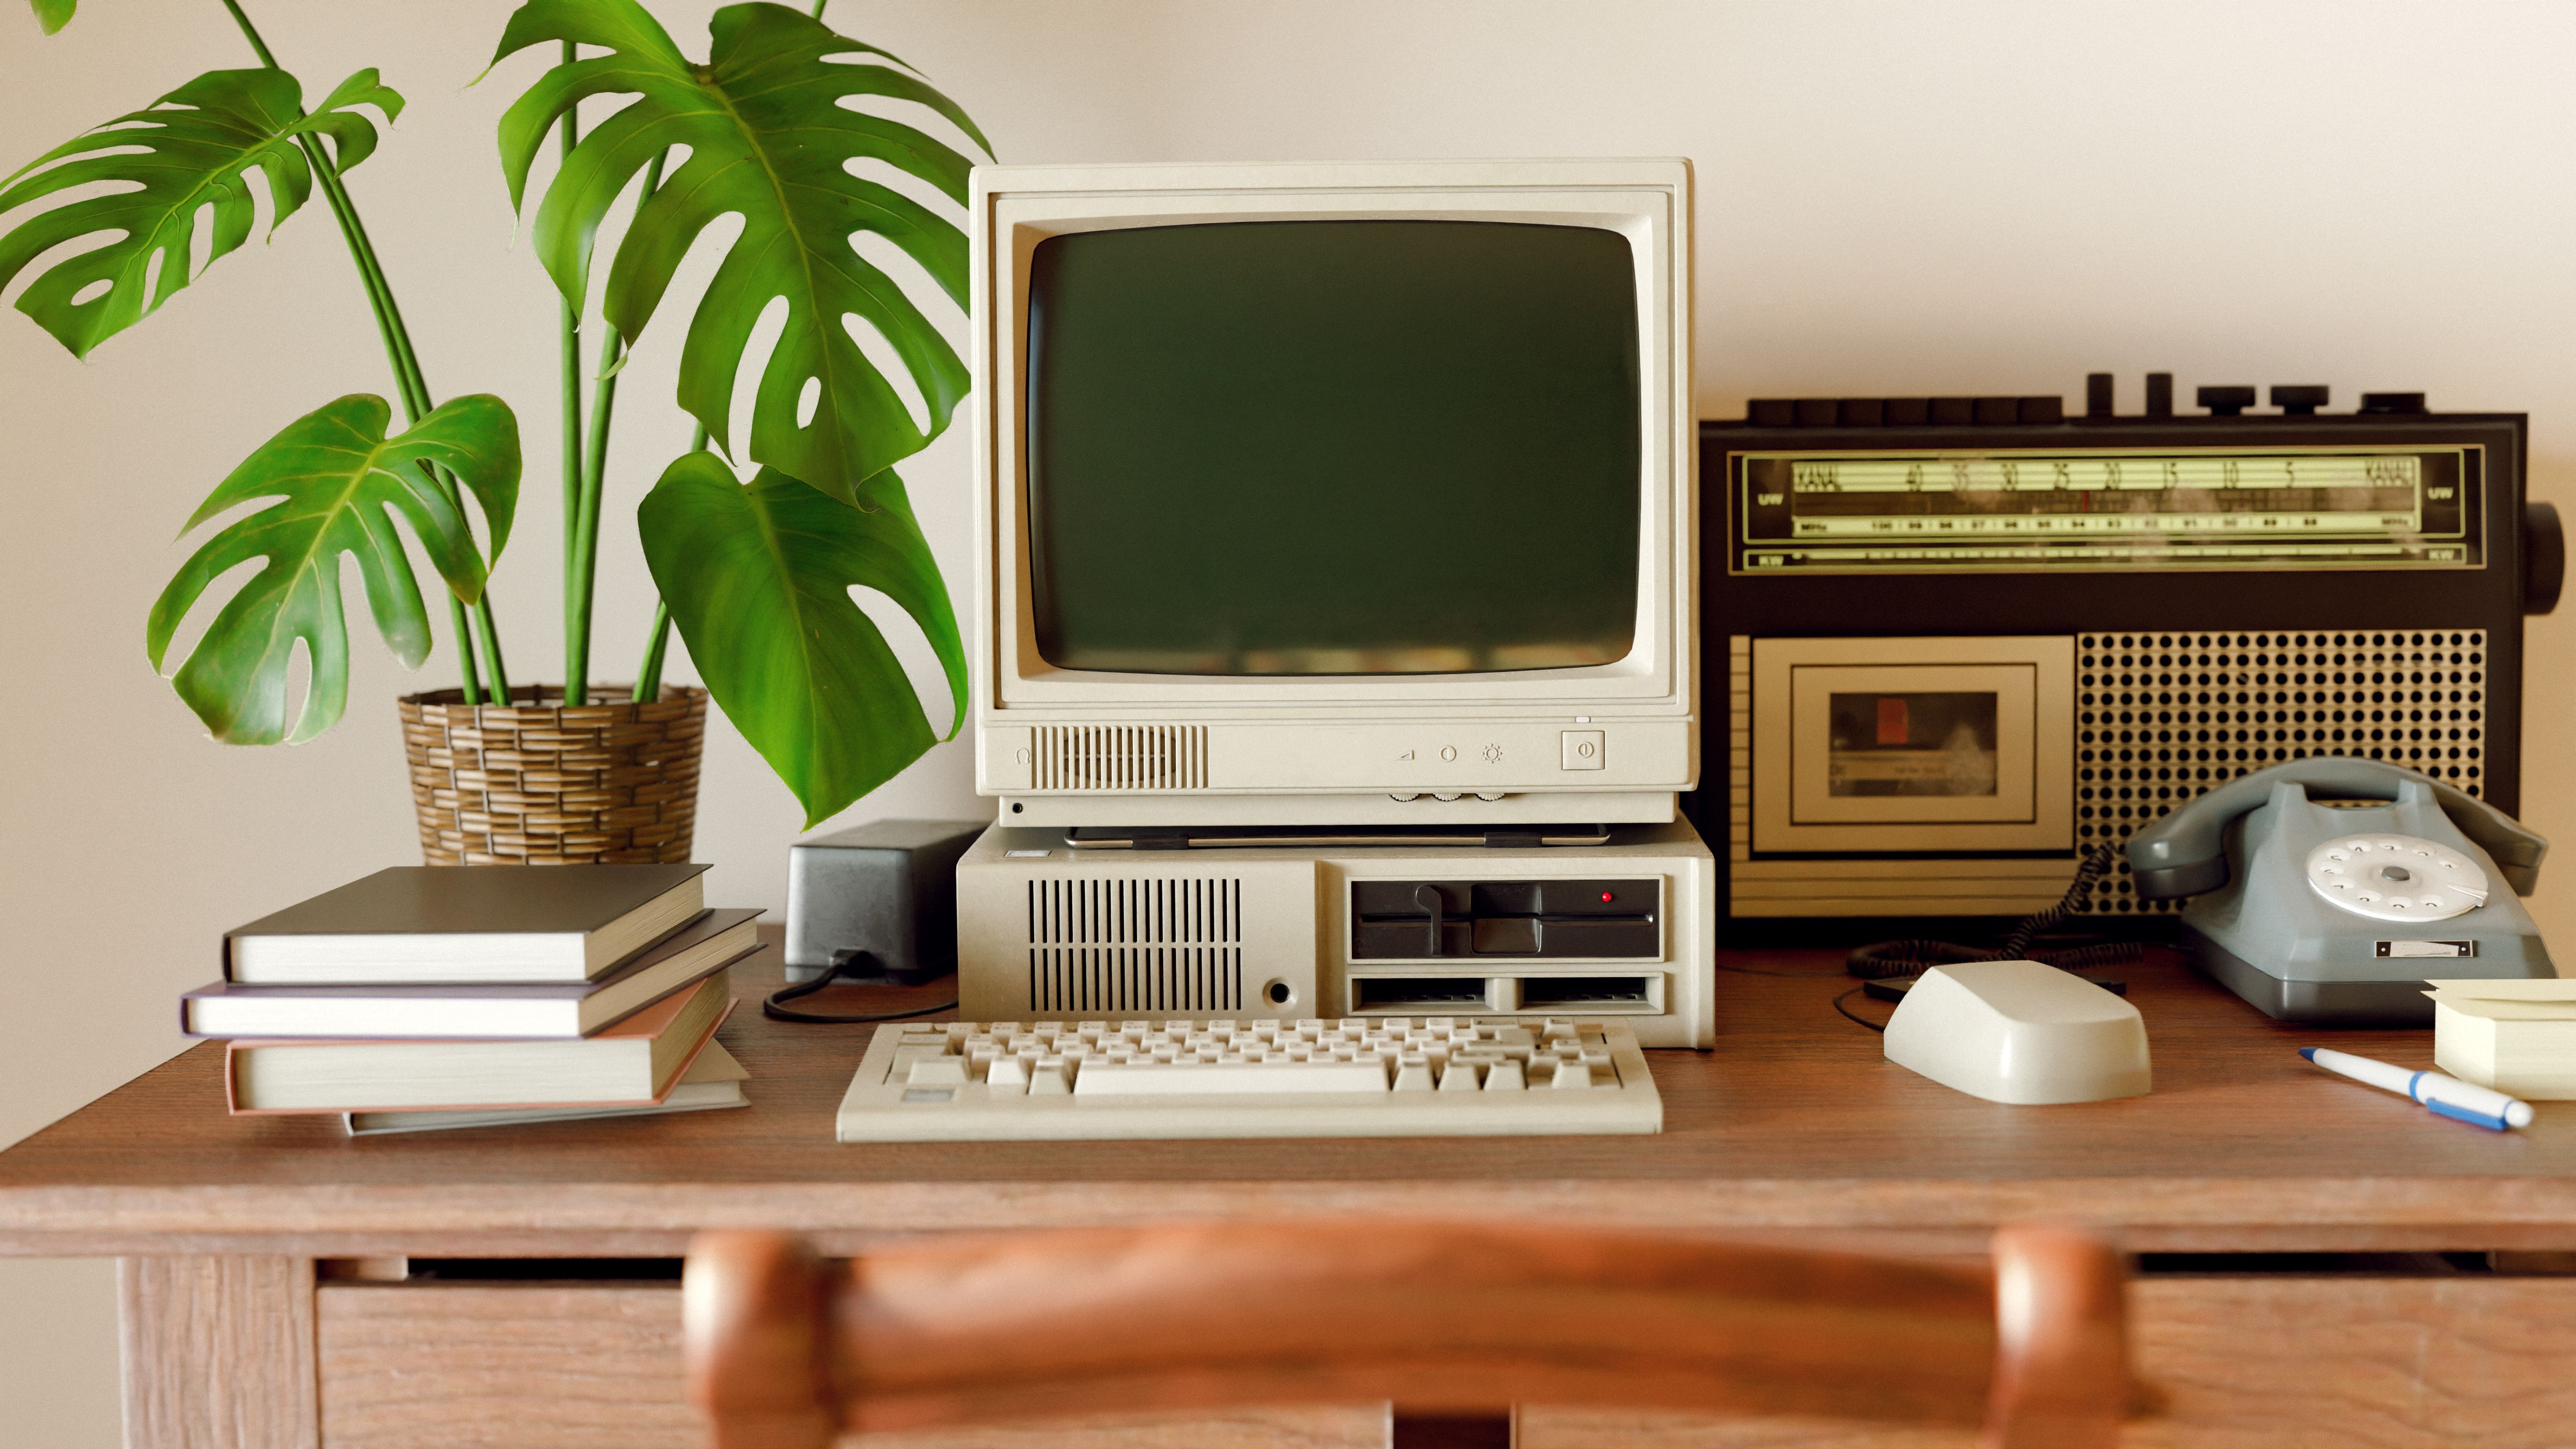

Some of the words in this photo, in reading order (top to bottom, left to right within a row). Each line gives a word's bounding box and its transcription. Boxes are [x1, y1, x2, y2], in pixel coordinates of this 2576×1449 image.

[1907, 463, 1923, 492] 40
[2001, 463, 2018, 491] 30
[2054, 462, 2070, 491] 25
[2104, 462, 2121, 490] 20
[2163, 462, 2178, 489] 15
[2223, 461, 2239, 489] 10
[2286, 460, 2295, 489] 5
